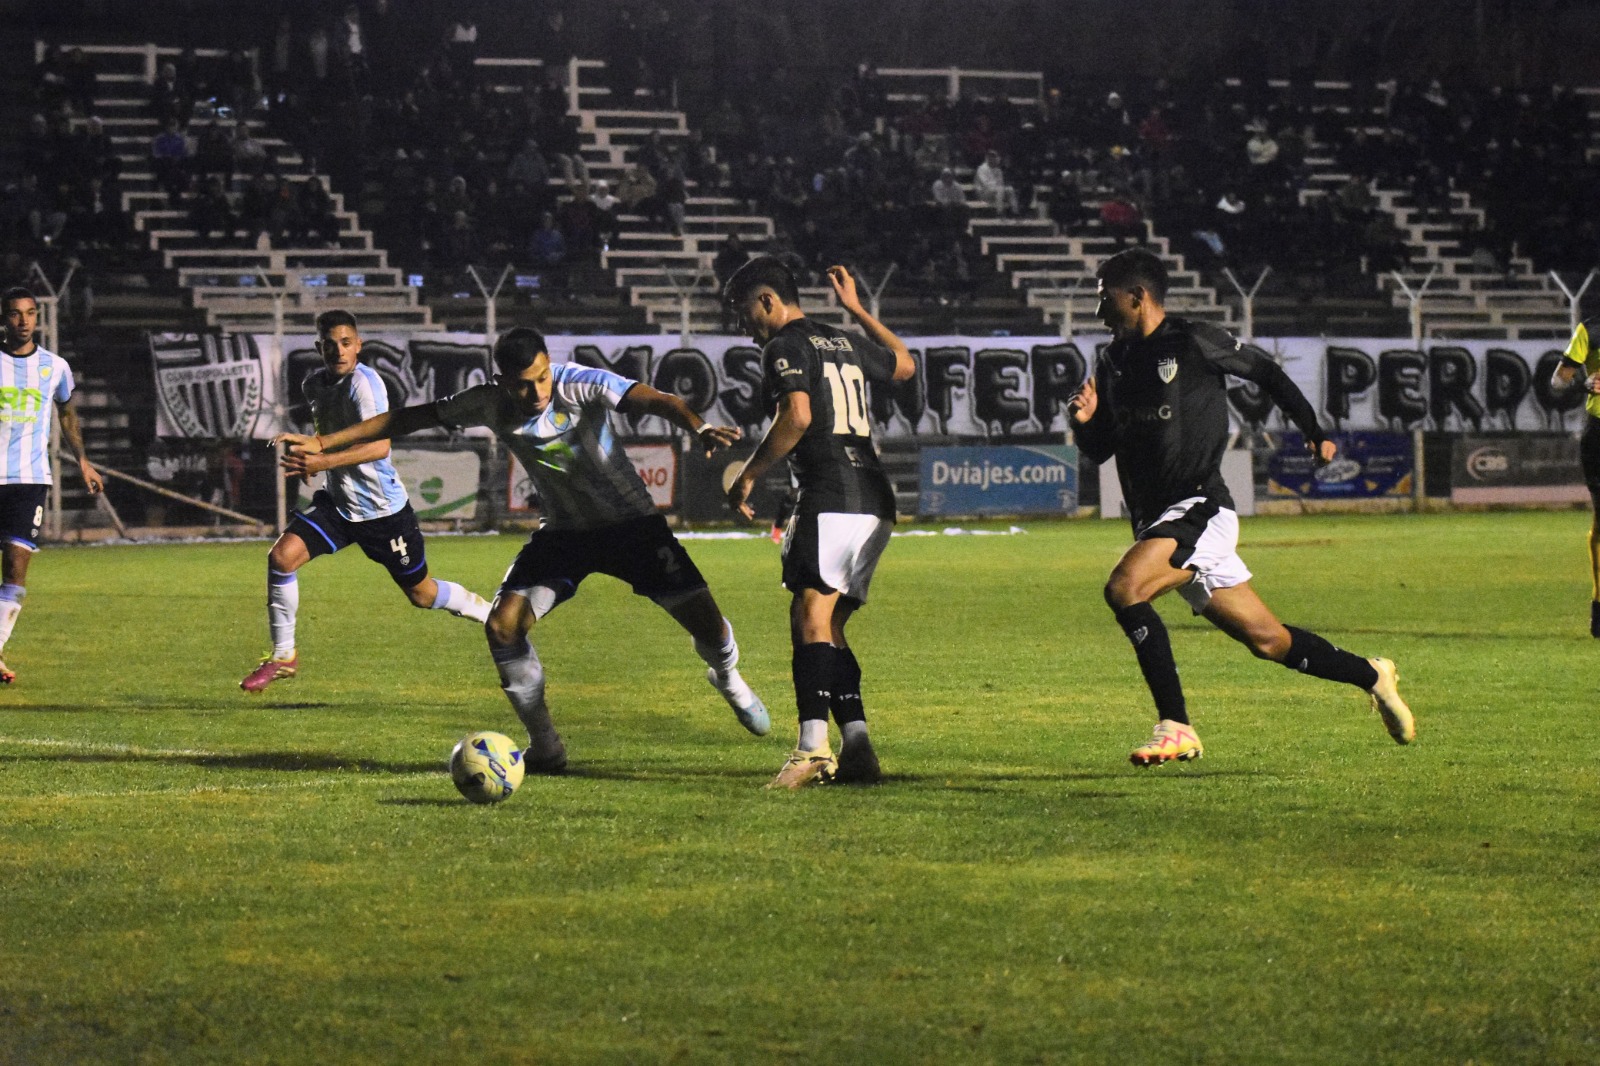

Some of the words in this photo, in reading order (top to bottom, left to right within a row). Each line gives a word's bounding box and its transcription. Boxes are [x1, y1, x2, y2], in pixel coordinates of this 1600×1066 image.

[823, 361, 871, 437] 10
[932, 460, 1067, 491] Dviajes.com
[33, 505, 44, 528] 8
[390, 535, 408, 557] 4
[655, 545, 682, 574] 2
